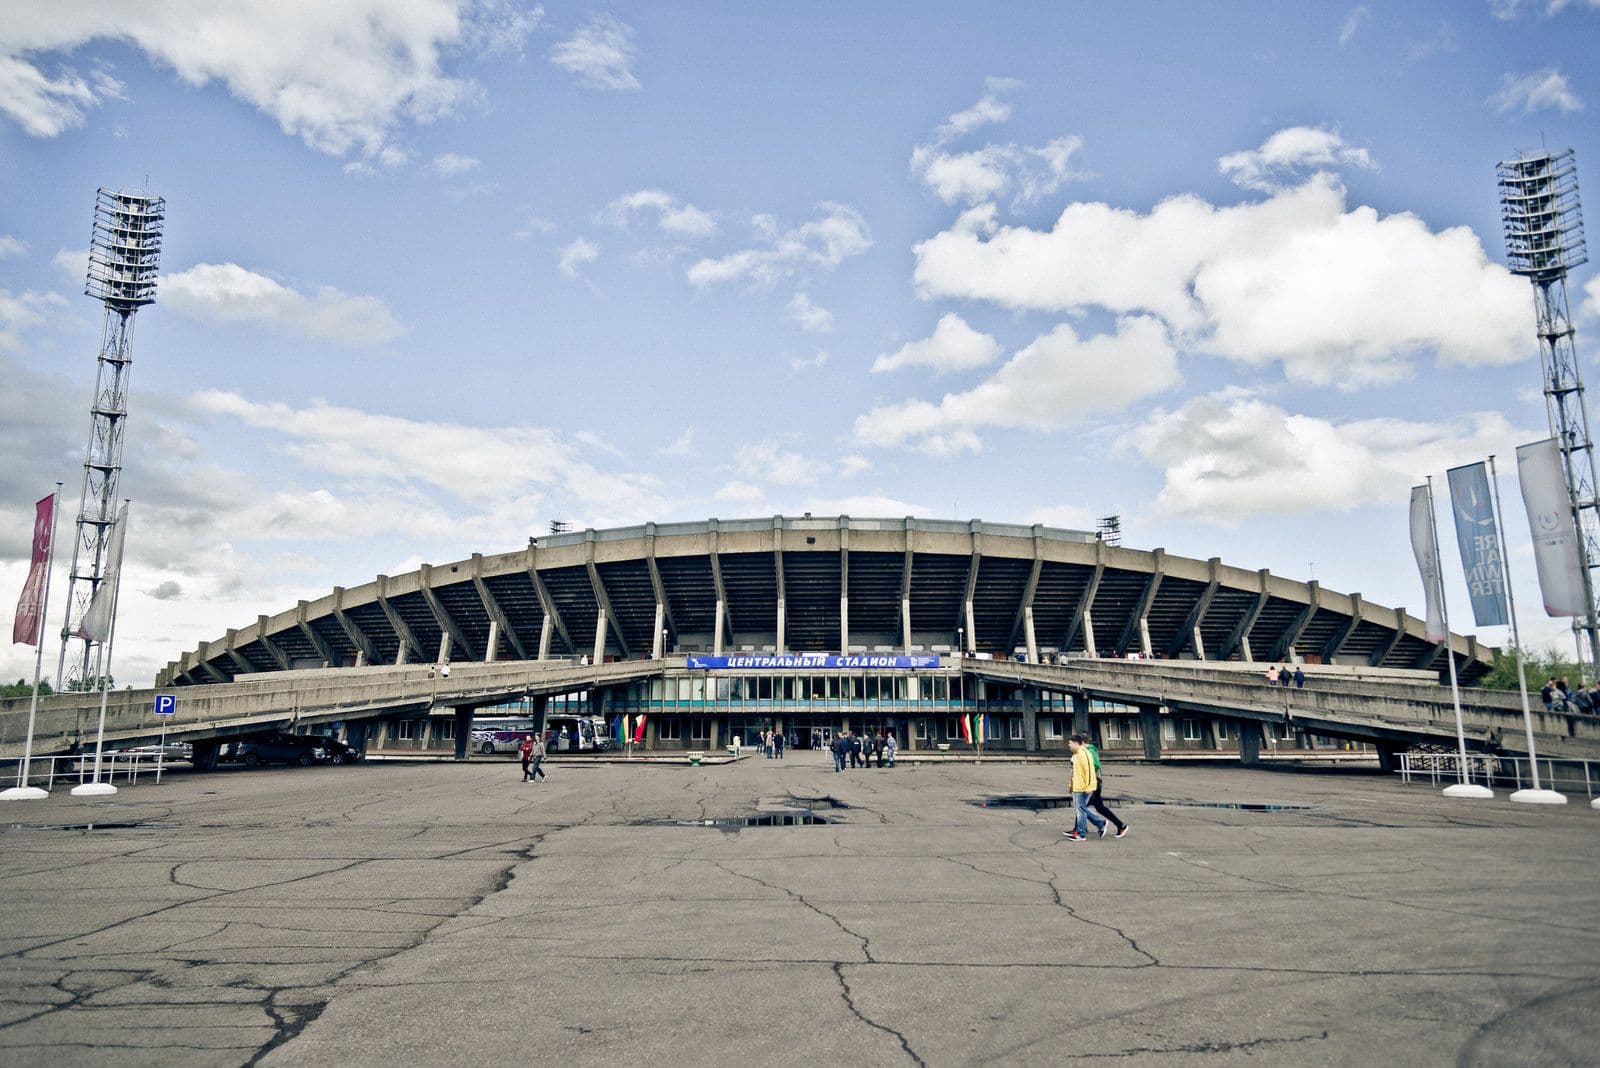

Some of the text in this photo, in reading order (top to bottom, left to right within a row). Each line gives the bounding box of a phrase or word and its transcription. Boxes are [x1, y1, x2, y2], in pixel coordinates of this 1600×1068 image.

[727, 656, 897, 668] ЦЕНТРАЛЬНЫЙ СТАДИОН
[160, 696, 172, 712] P
